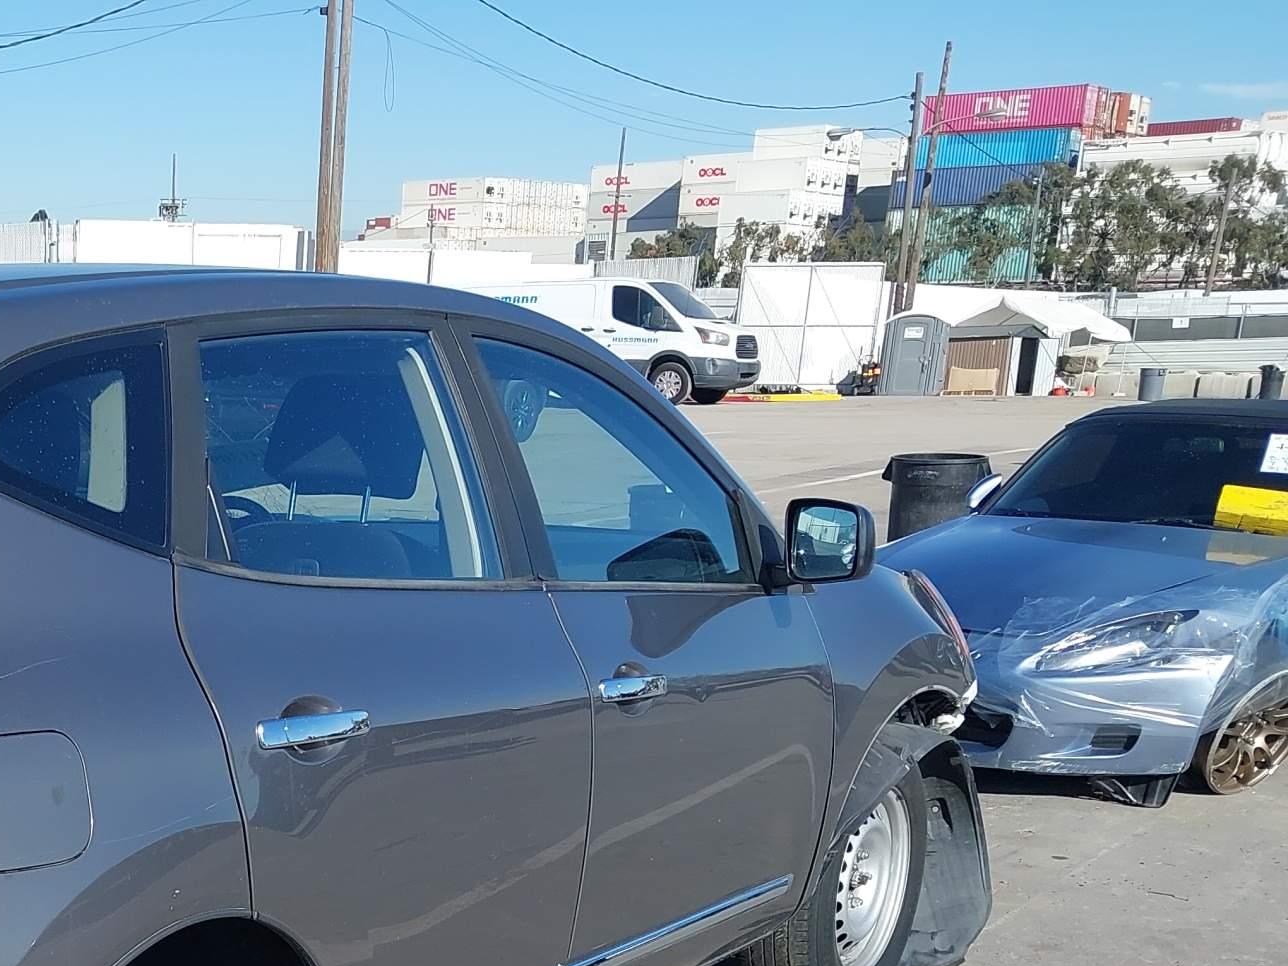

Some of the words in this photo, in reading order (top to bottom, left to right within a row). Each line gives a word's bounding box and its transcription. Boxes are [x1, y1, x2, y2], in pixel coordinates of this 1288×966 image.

[698, 167, 727, 178] OOCL
[428, 182, 457, 197] ONE
[427, 207, 456, 222] ONE
